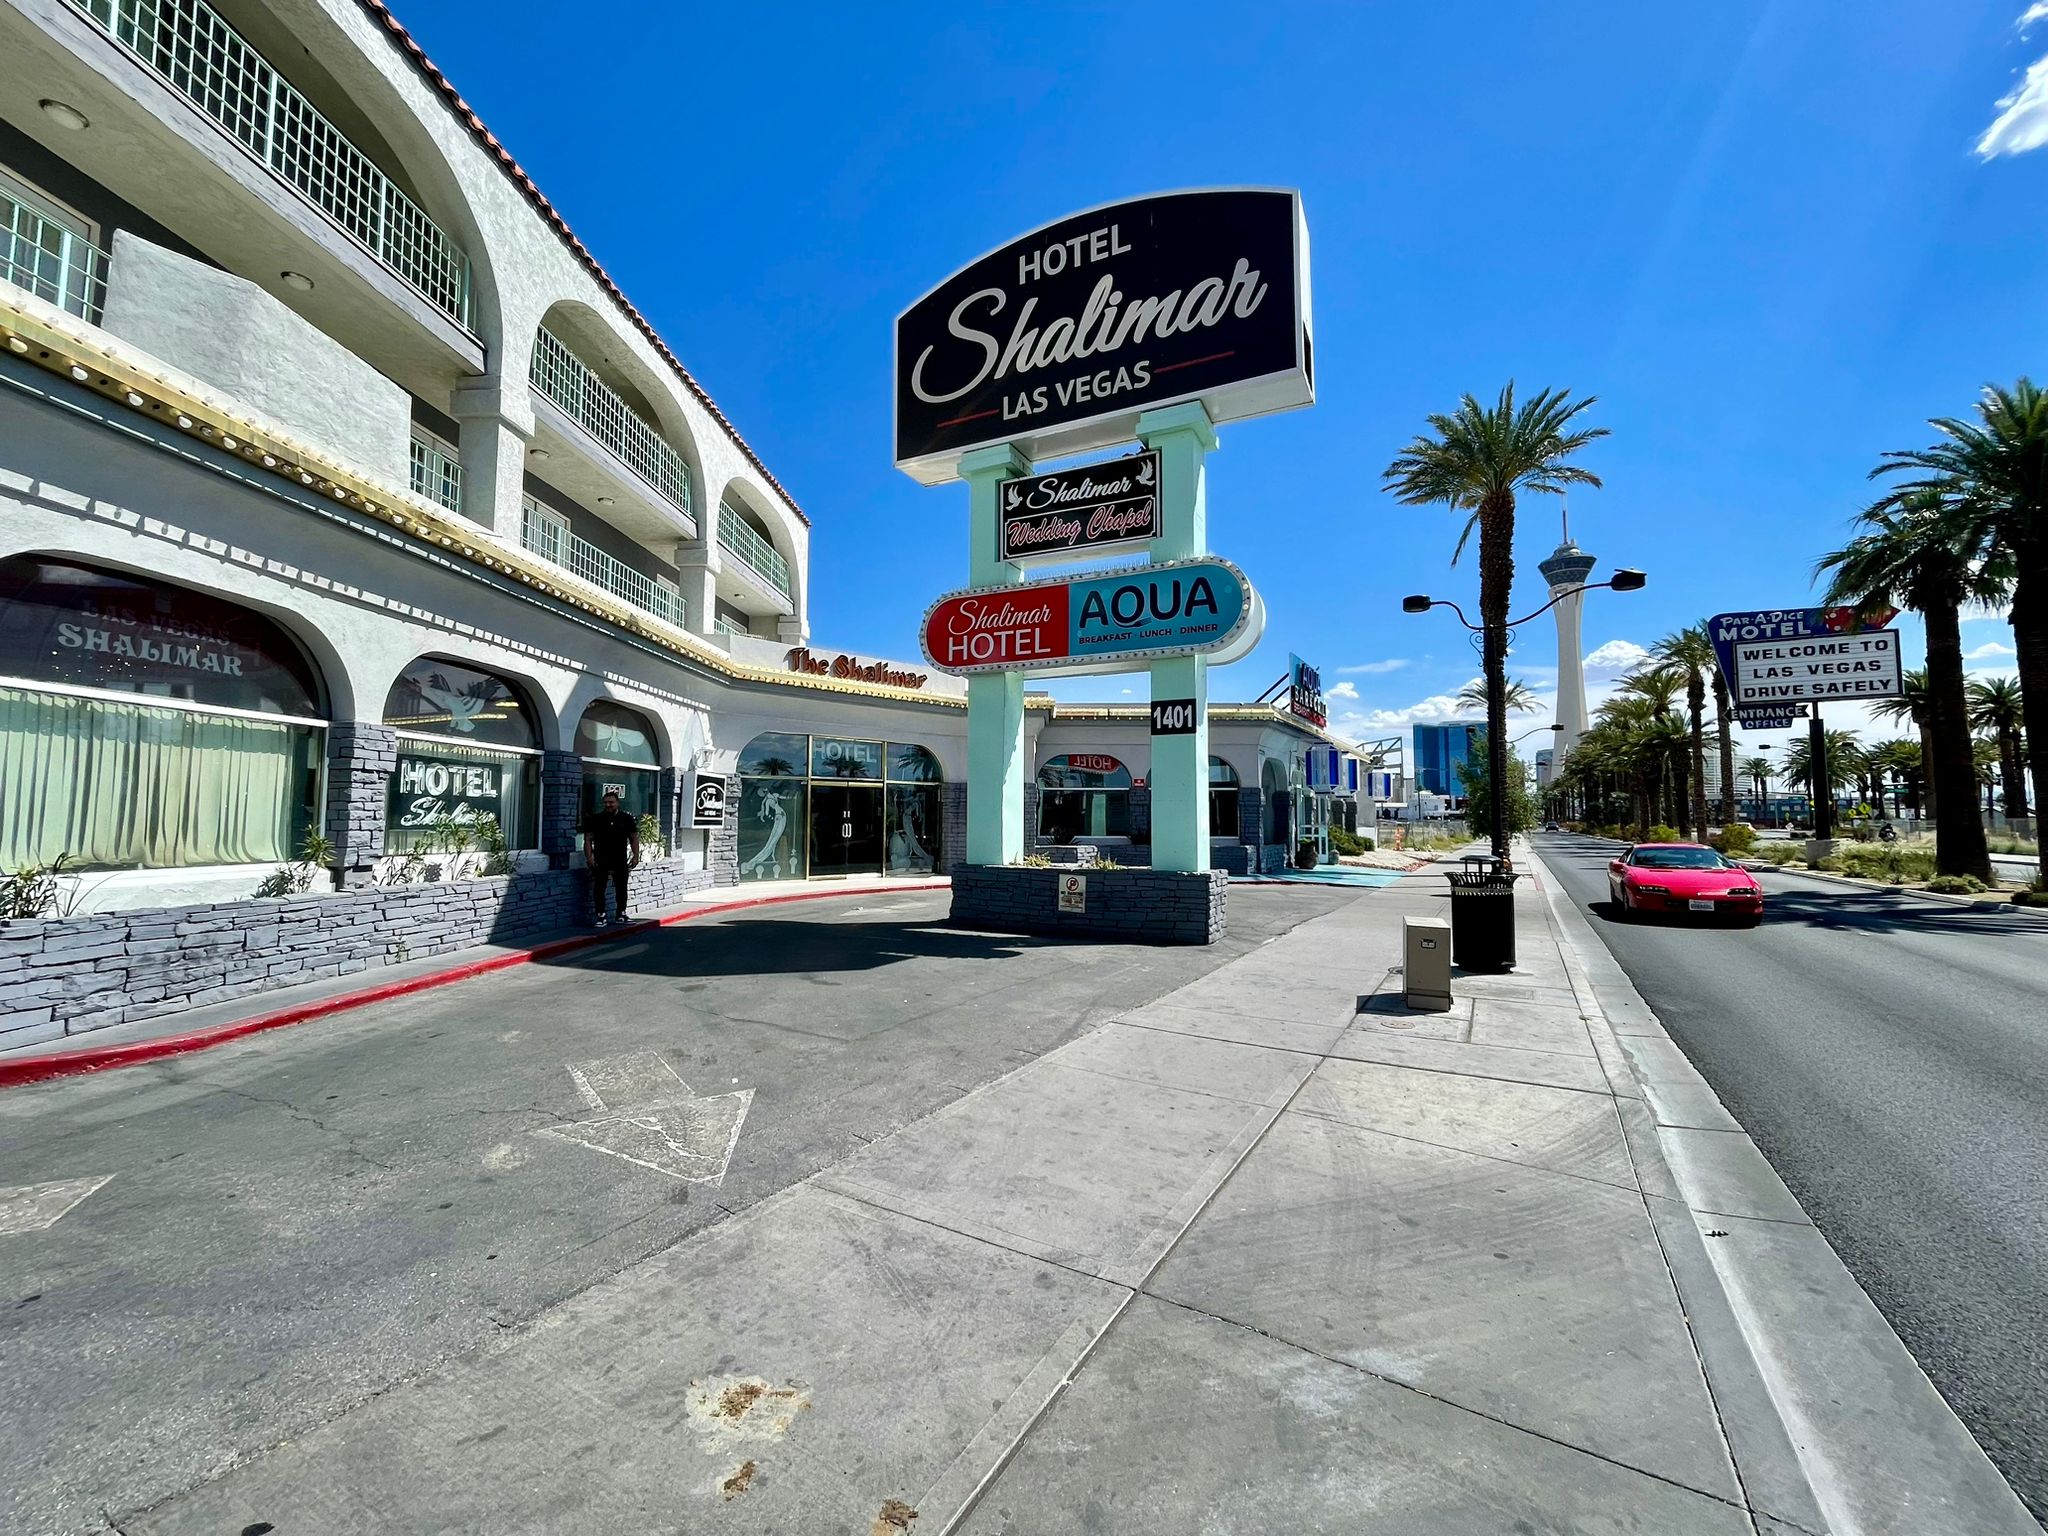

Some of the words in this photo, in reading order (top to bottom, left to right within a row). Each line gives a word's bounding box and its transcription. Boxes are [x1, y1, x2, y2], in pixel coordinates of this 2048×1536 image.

[1018, 224, 1131, 285] HOTEL
[911, 258, 1269, 403] Shalimar
[1002, 386, 1048, 421] LAS
[1057, 360, 1151, 406] VEGAS
[1026, 477, 1132, 509] Shalimar
[1008, 518, 1081, 547] Wedding
[1087, 500, 1152, 540] Chapel
[948, 600, 1051, 636] Shalimar
[1079, 576, 1218, 629] AQUA
[948, 628, 1051, 661] HOTEL
[1079, 632, 1132, 645] BREAKFAST
[1139, 627, 1172, 639] LUNCH
[1180, 623, 1218, 635] DINNER
[1719, 622, 1811, 641] MOTEL
[57, 622, 244, 677] SHALIMAR
[1743, 642, 1850, 661] WELCOME
[1860, 639, 1888, 652] TO
[785, 647, 829, 676] The
[831, 655, 928, 689] Shalimar
[1754, 666, 1794, 679] LAS
[1807, 660, 1881, 675] VEGAS
[1744, 684, 1804, 698] DRIVE
[1812, 679, 1891, 694] SAFELY
[1153, 704, 1193, 729] 1401
[1731, 706, 1803, 720] ENTRANCE
[1745, 718, 1790, 729] OFFICE
[814, 741, 877, 763] HOTEL
[400, 760, 498, 797] HOTEL
